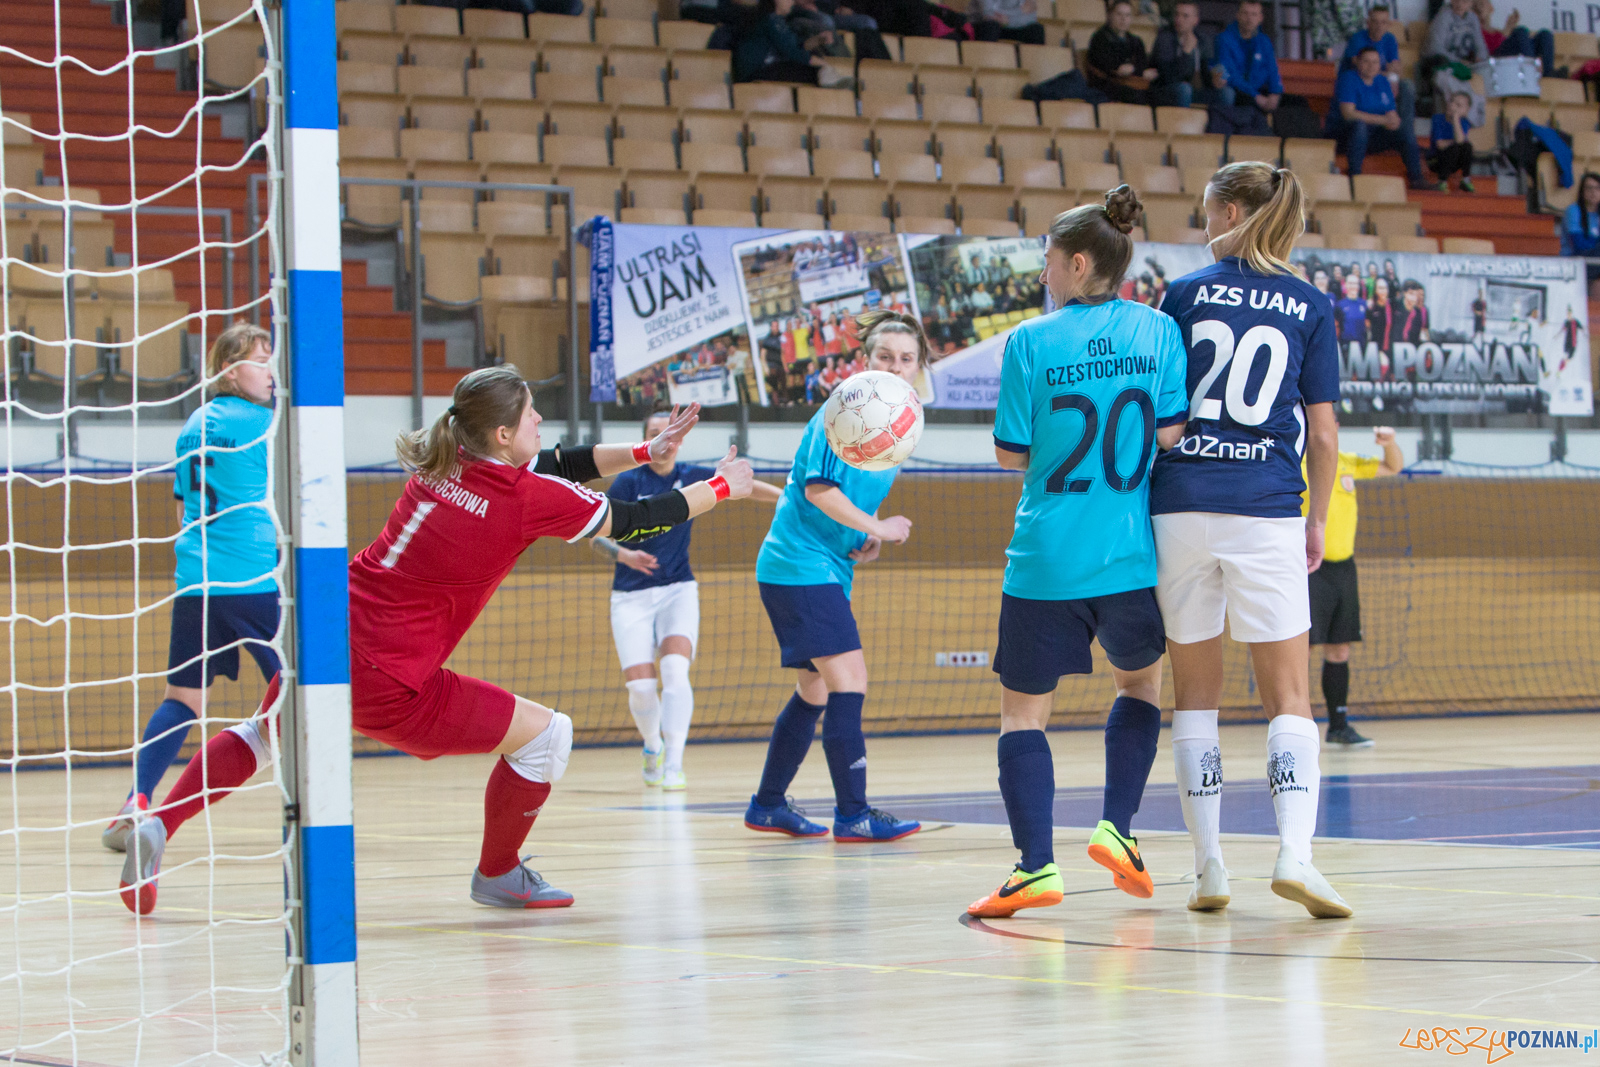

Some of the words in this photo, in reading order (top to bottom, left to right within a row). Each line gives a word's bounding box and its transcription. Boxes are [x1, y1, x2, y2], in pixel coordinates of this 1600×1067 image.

[1552, 0, 1575, 31] in
[616, 231, 702, 283] ULTRASI
[626, 254, 716, 318] UAM
[1193, 284, 1244, 306] AZS
[1249, 289, 1308, 321] UAM
[1087, 337, 1116, 358] GOL
[1046, 354, 1157, 387] CZĘSTOCHOWA
[1189, 319, 1289, 426] 20
[964, 390, 982, 401] AZS
[1044, 386, 1157, 496] 20
[190, 456, 218, 526] 5
[379, 502, 438, 568] 1
[1187, 787, 1219, 798] Futsal
[1279, 784, 1309, 794] Kobiet
